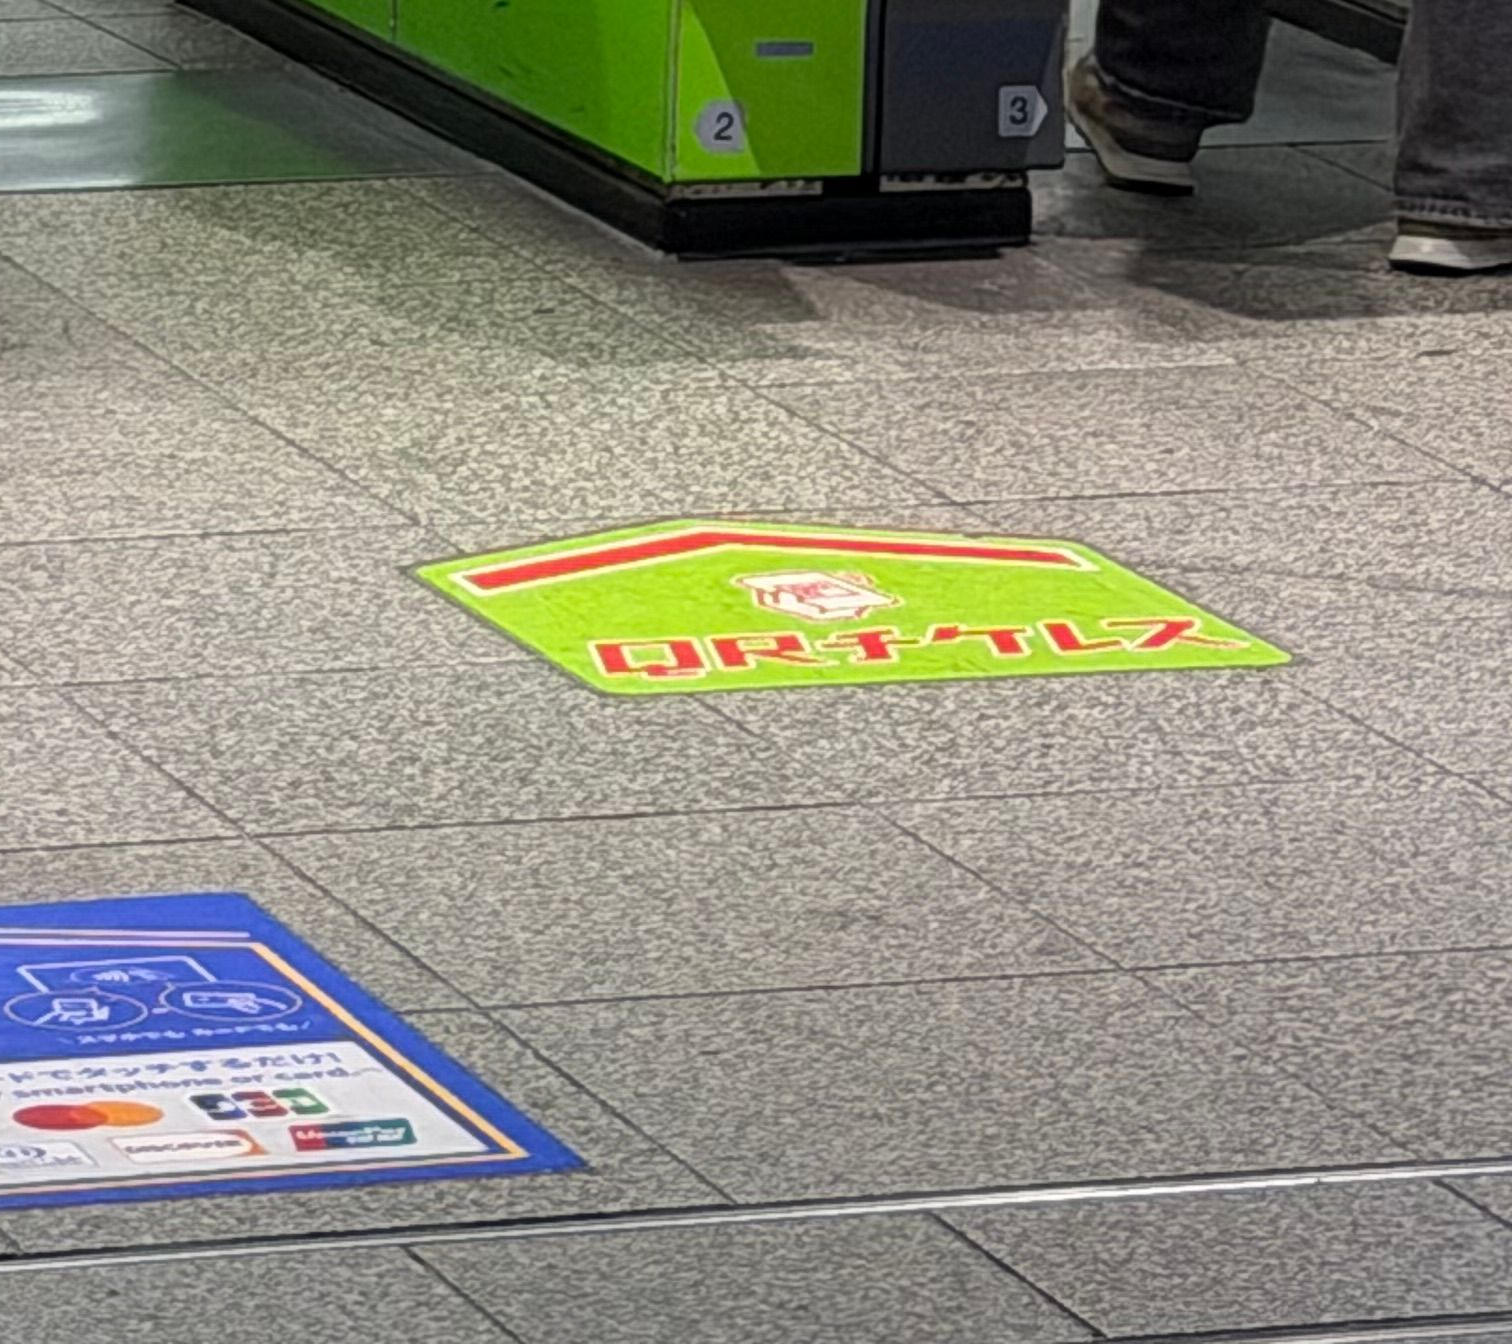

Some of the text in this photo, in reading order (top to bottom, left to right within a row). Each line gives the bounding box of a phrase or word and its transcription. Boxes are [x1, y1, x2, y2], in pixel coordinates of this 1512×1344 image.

[714, 111, 734, 141] 2
[1009, 96, 1029, 126] 3
[591, 615, 1250, 680] QRチケレス
